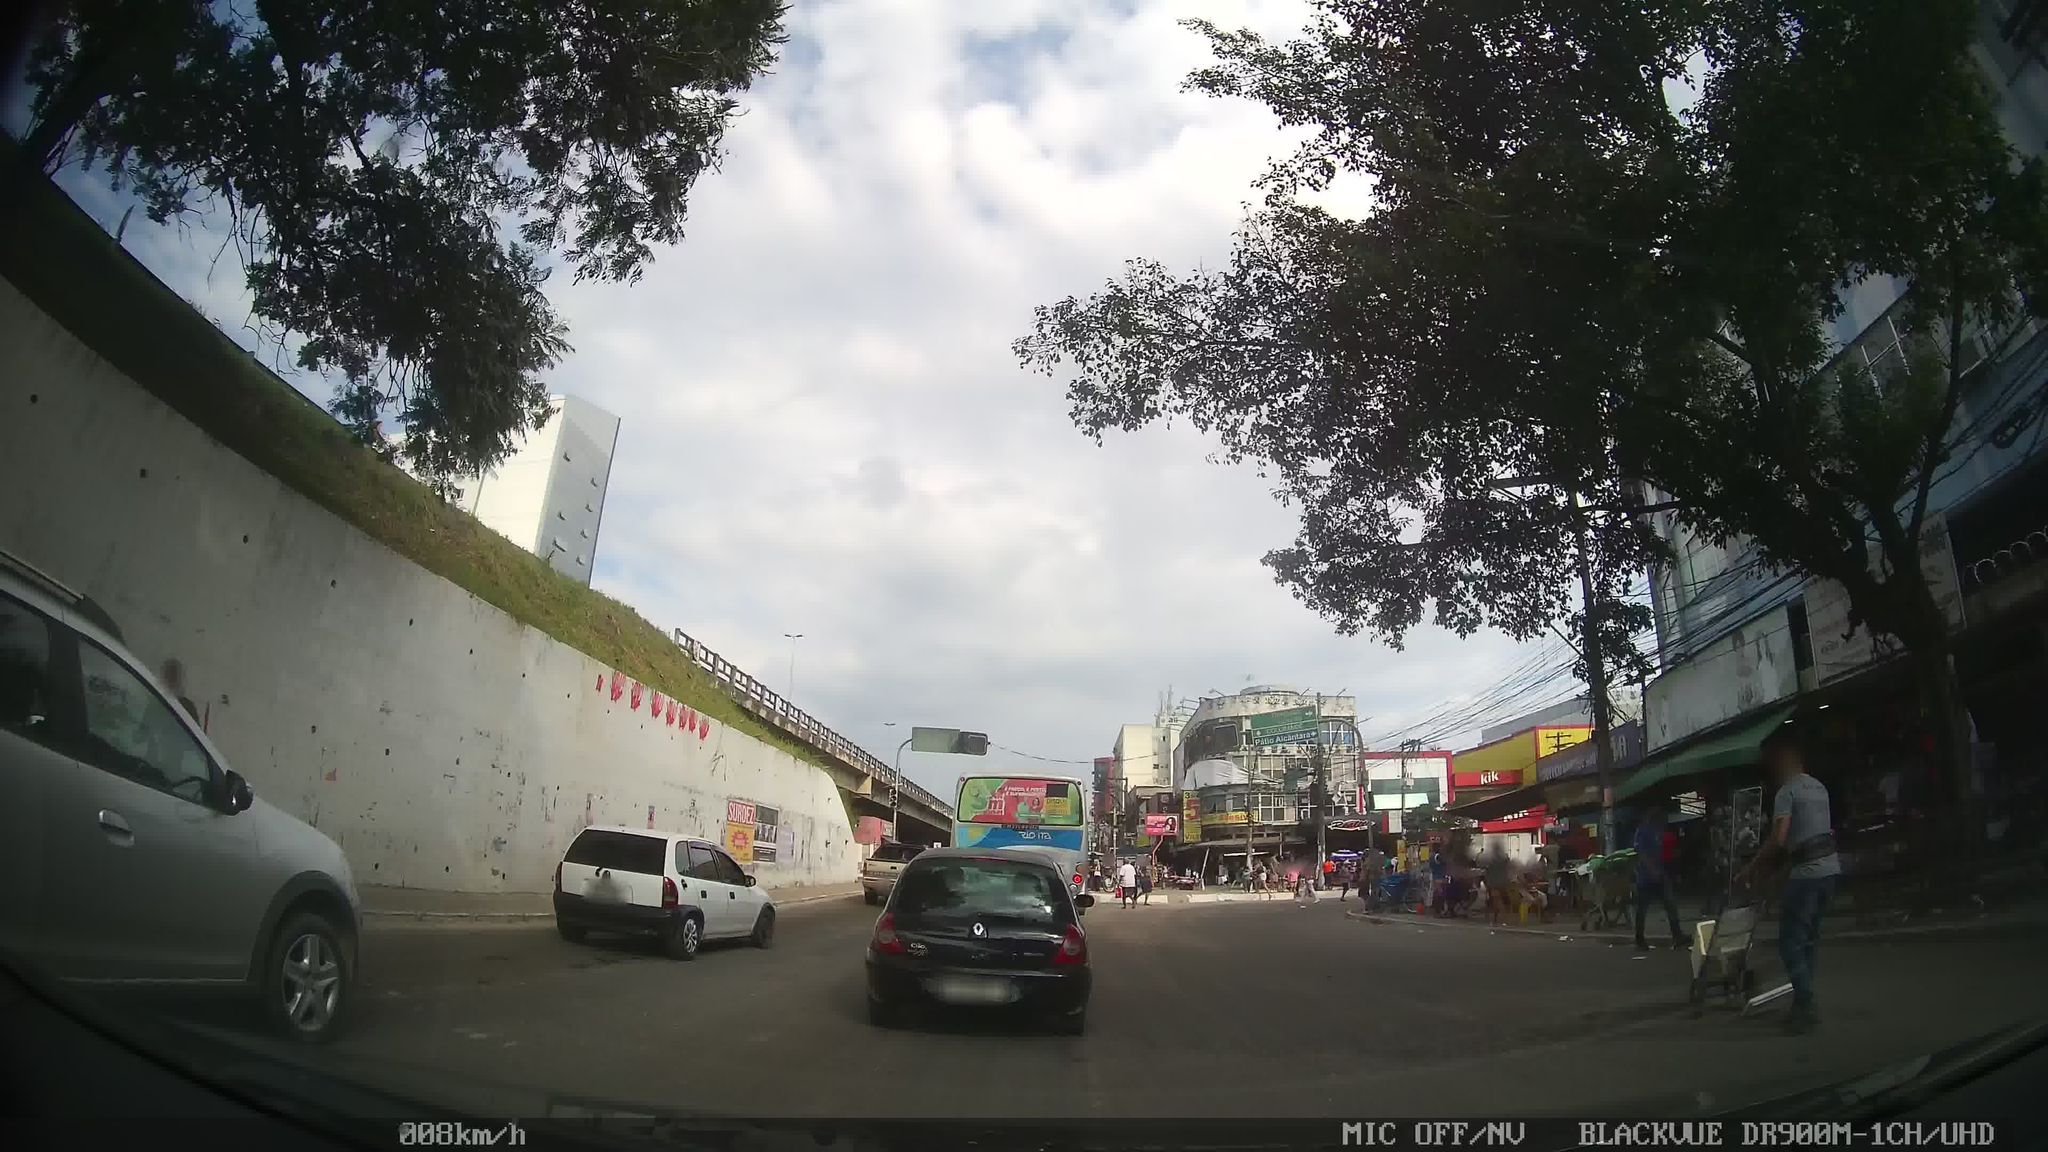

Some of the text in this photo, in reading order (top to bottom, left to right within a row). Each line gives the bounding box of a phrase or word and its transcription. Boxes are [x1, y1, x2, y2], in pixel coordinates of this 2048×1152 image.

[1275, 732, 1311, 744] Alcântara
[1481, 771, 1499, 785] kik
[728, 802, 755, 825] SURDEZ
